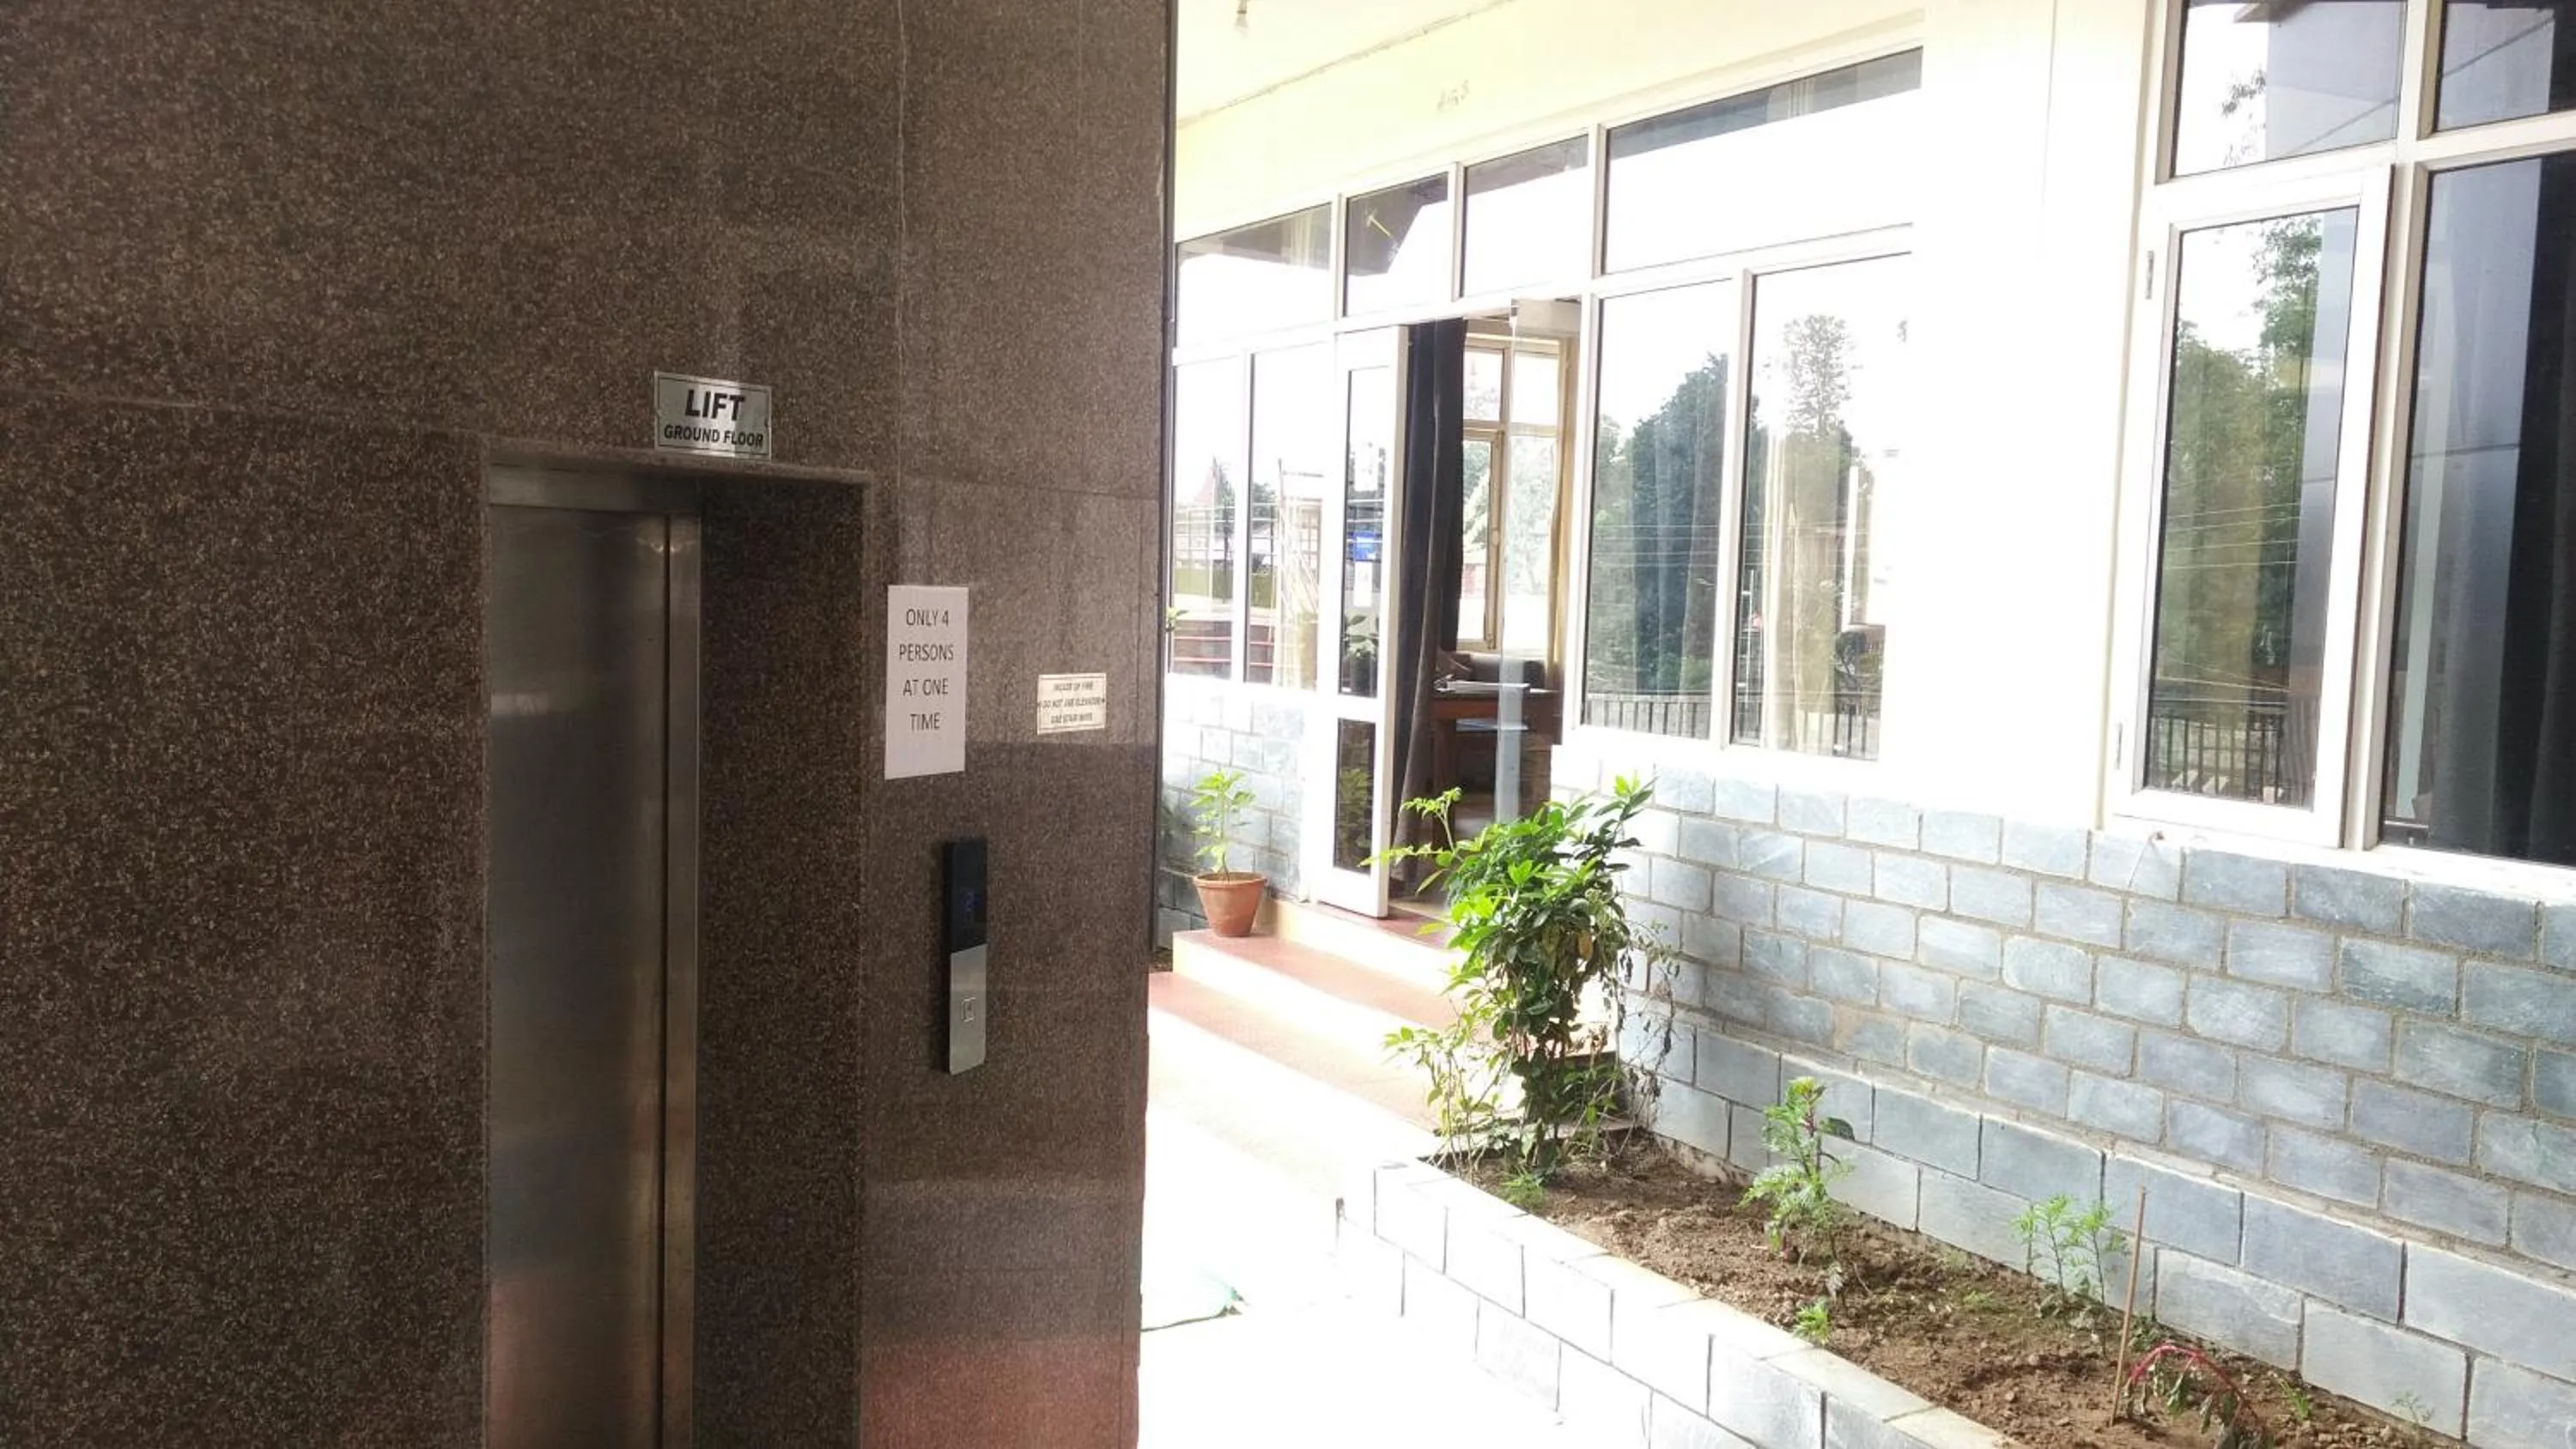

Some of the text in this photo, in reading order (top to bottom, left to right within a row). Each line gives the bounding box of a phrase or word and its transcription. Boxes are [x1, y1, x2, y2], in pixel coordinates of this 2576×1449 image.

[685, 389, 745, 421] LIFT
[664, 424, 763, 447] GROUND FLOOR
[906, 609, 949, 627] ONLY 4
[899, 644, 954, 661] PERSONS
[902, 678, 949, 696] AT ONE
[910, 712, 940, 731] TIME
